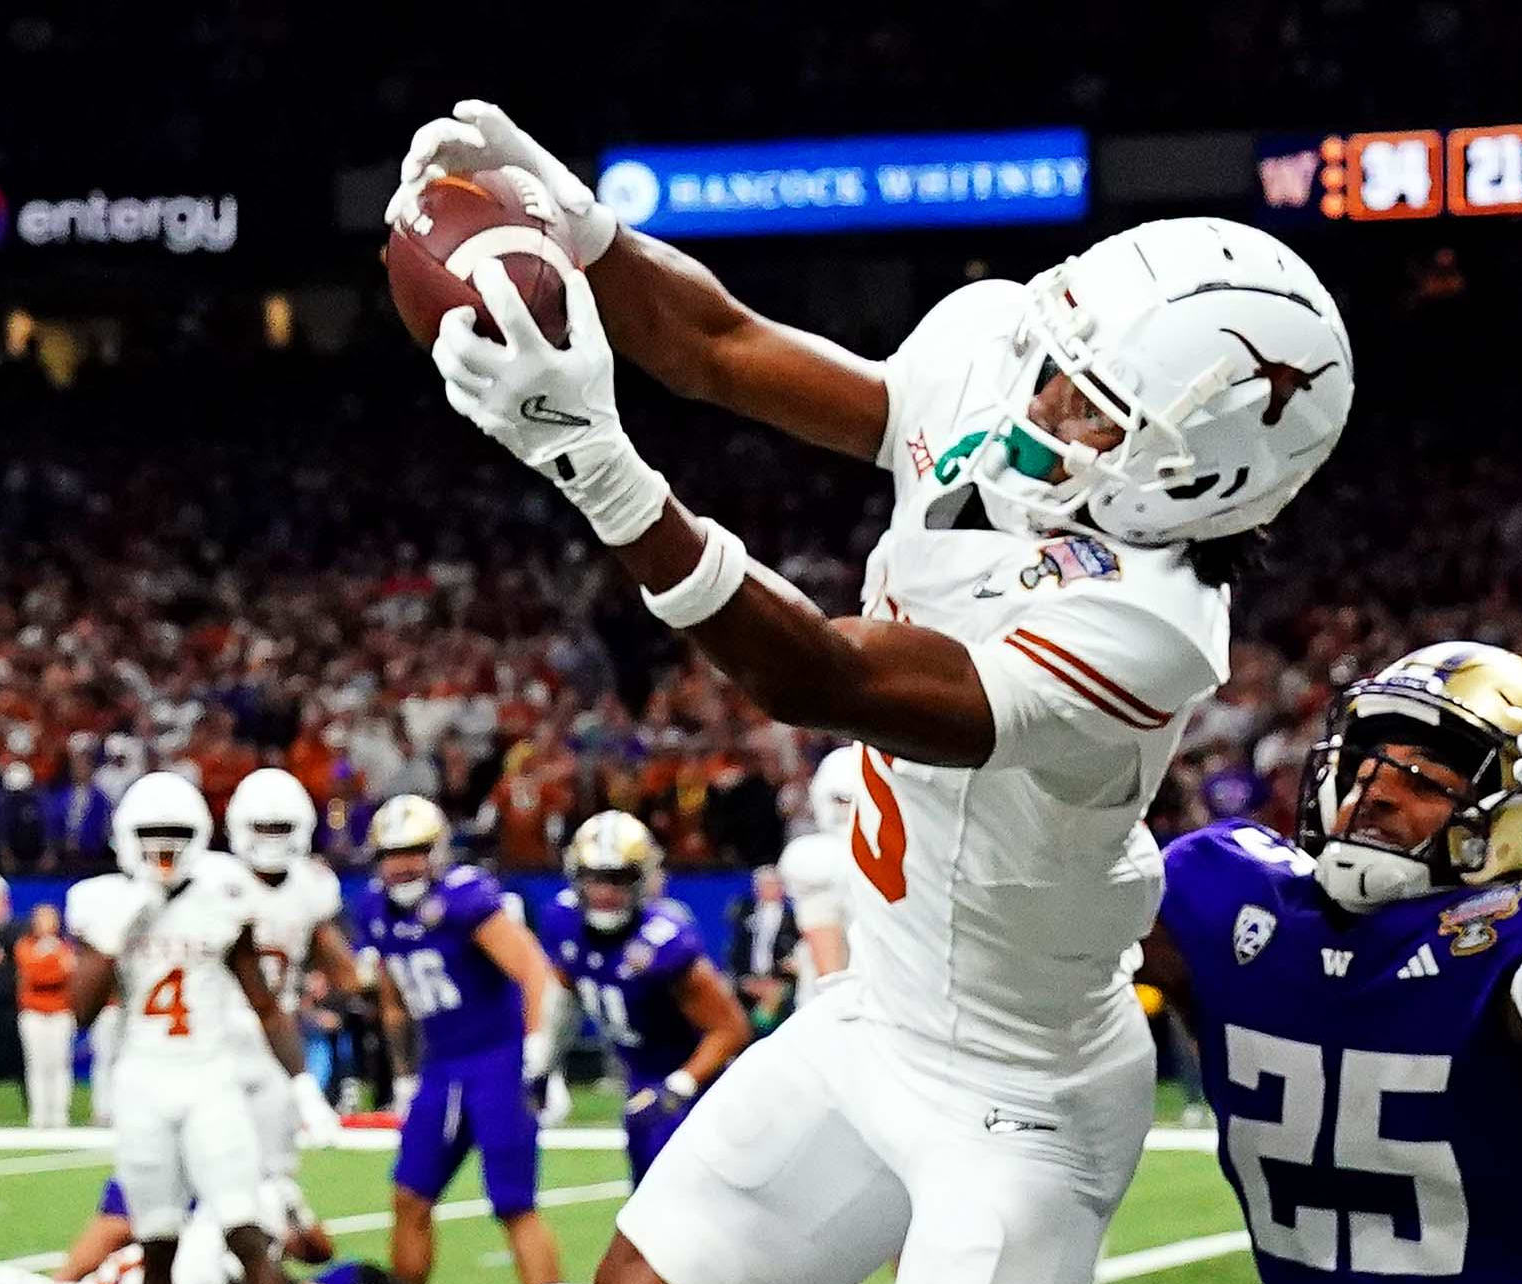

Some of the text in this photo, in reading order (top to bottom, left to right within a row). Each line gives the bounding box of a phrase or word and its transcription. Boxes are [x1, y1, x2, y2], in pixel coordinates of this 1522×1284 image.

[668, 155, 1087, 213] HANCOCK WHITNEY
[16, 188, 239, 253] entergy
[1320, 947, 1355, 978] W
[142, 966, 191, 1036] 4
[1224, 1023, 1470, 1277] 25
